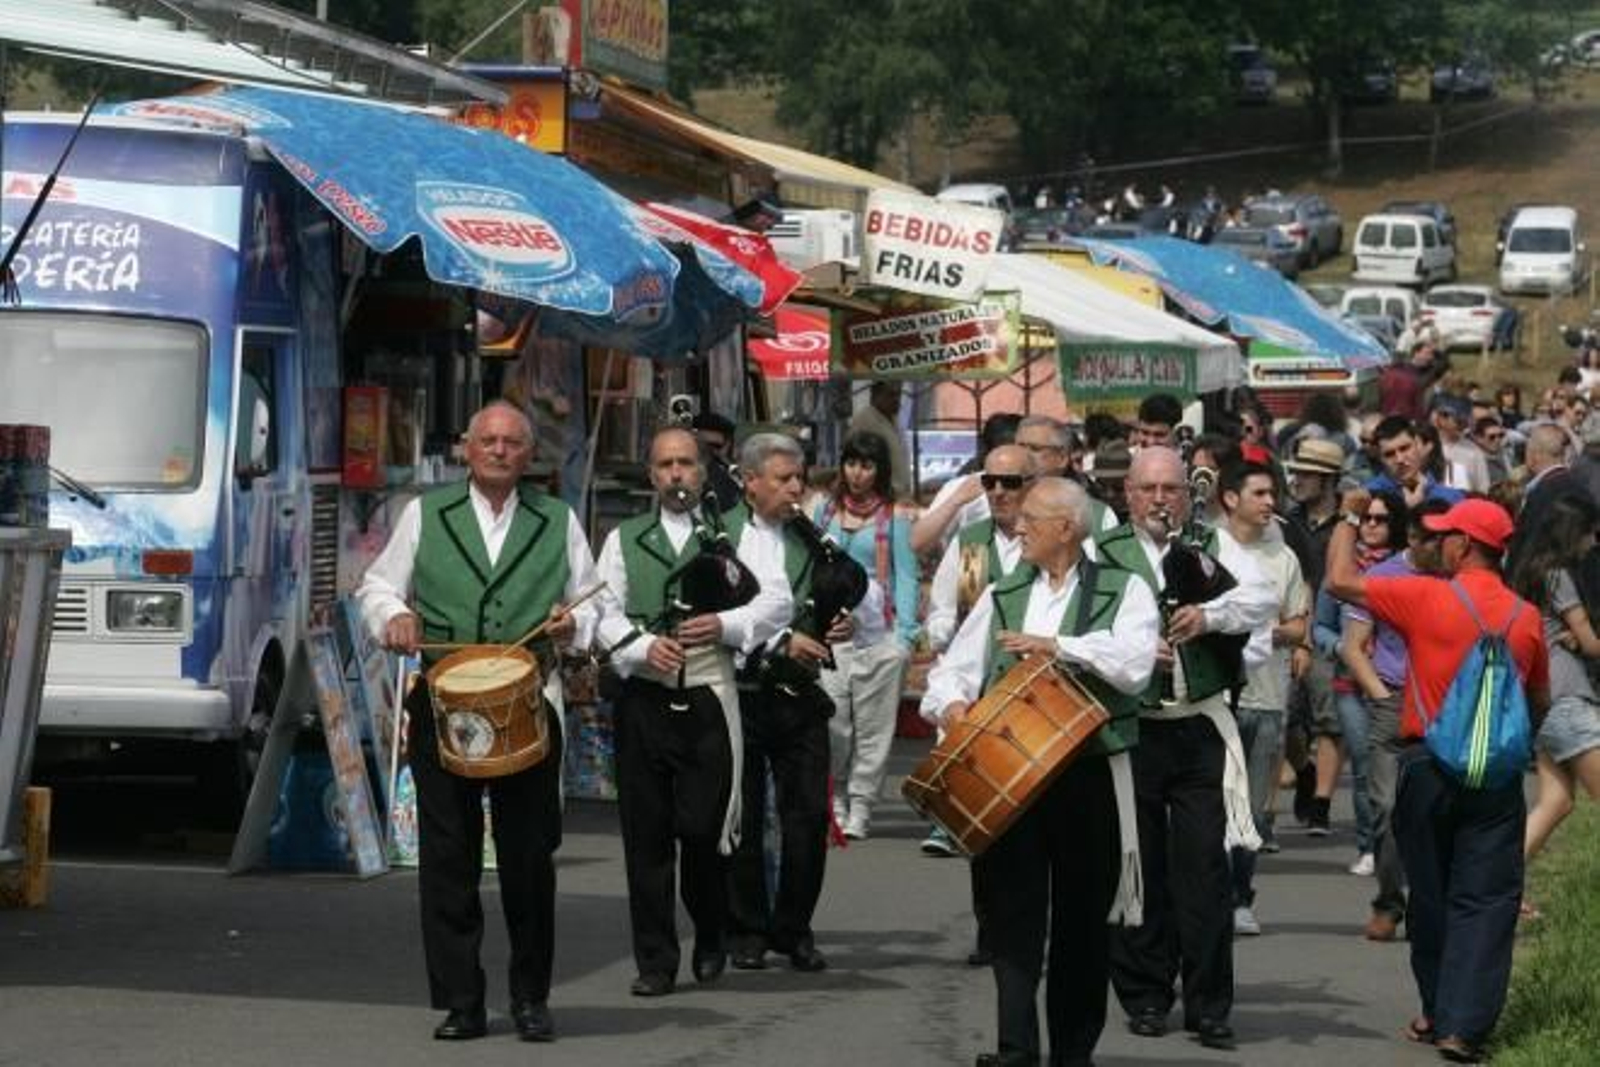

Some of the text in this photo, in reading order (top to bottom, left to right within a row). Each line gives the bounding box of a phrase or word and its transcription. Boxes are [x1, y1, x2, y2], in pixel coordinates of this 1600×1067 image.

[866, 210, 993, 255] BEBIDAS
[876, 251, 964, 288] FRIAS
[875, 340, 992, 371] GRANIZADOS
[924, 331, 938, 346] Y
